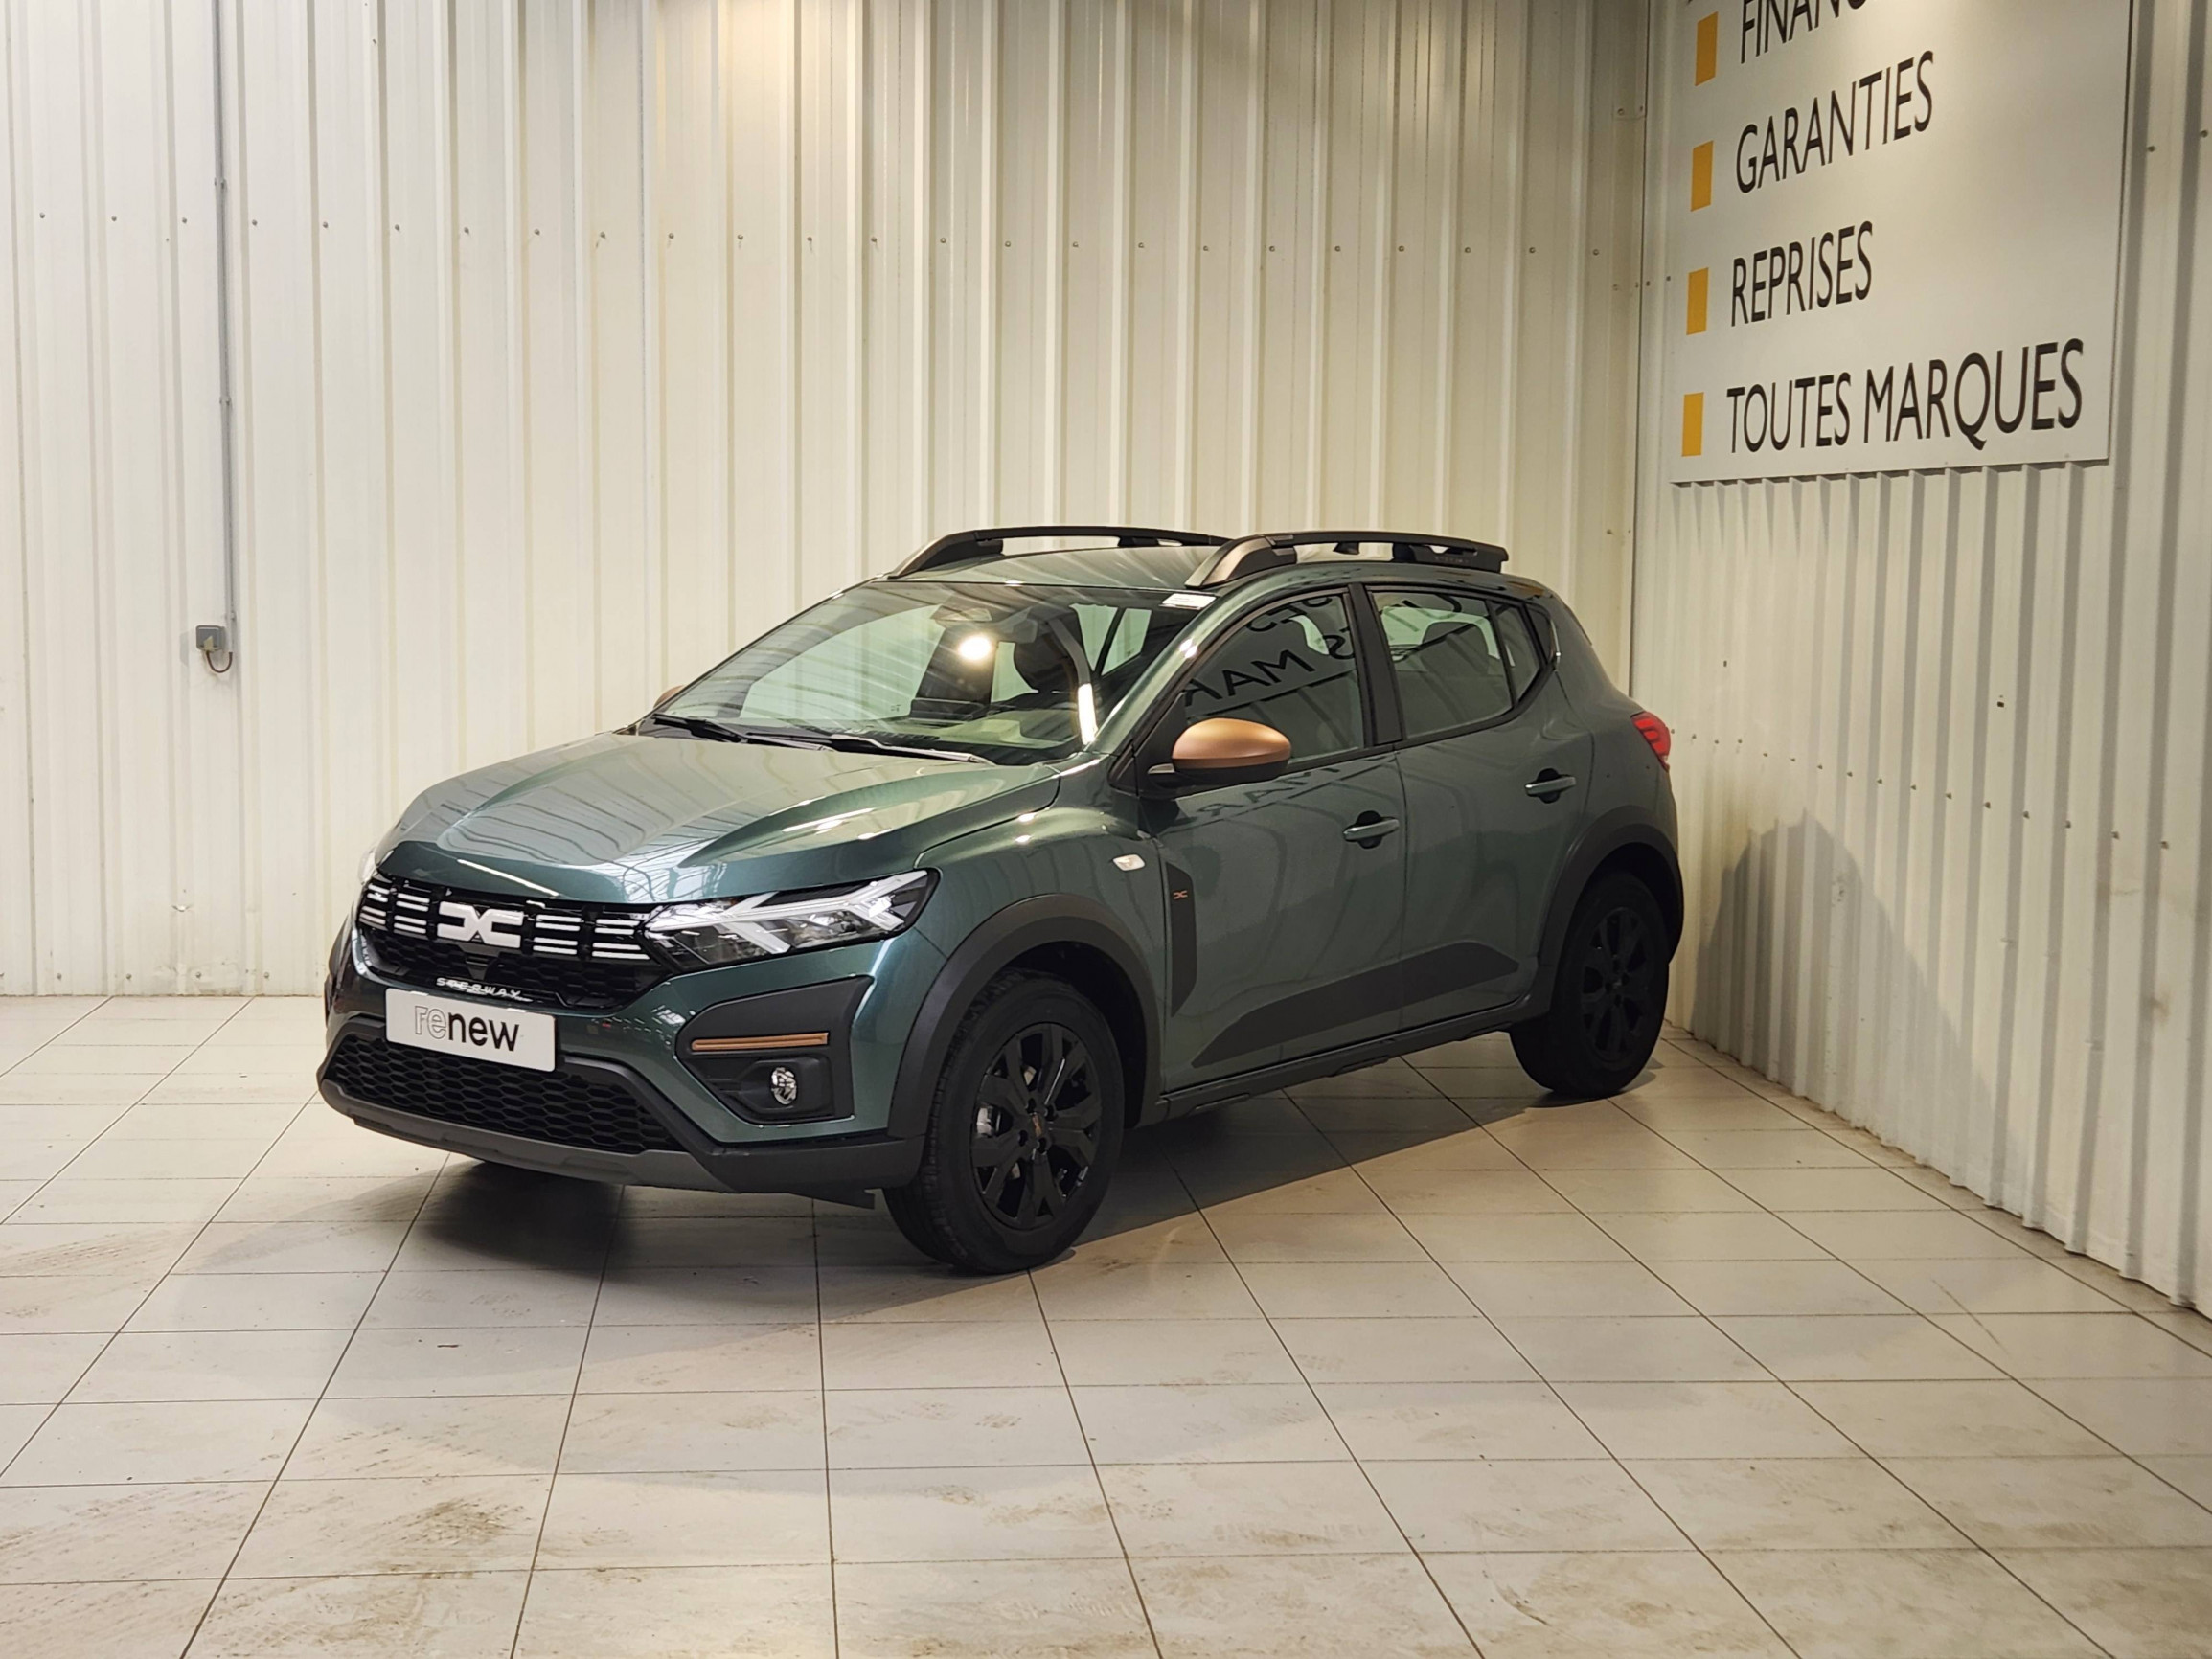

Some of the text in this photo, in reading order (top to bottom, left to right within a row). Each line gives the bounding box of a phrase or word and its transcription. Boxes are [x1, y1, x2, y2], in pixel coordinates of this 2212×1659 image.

[1741, 0, 1867, 64] FINA
[1735, 50, 1934, 193] GARANTIES
[1730, 220, 1874, 327] REPRISES
[1726, 338, 2085, 454] TOUTES MARQUES
[414, 1005, 520, 1052] renew
